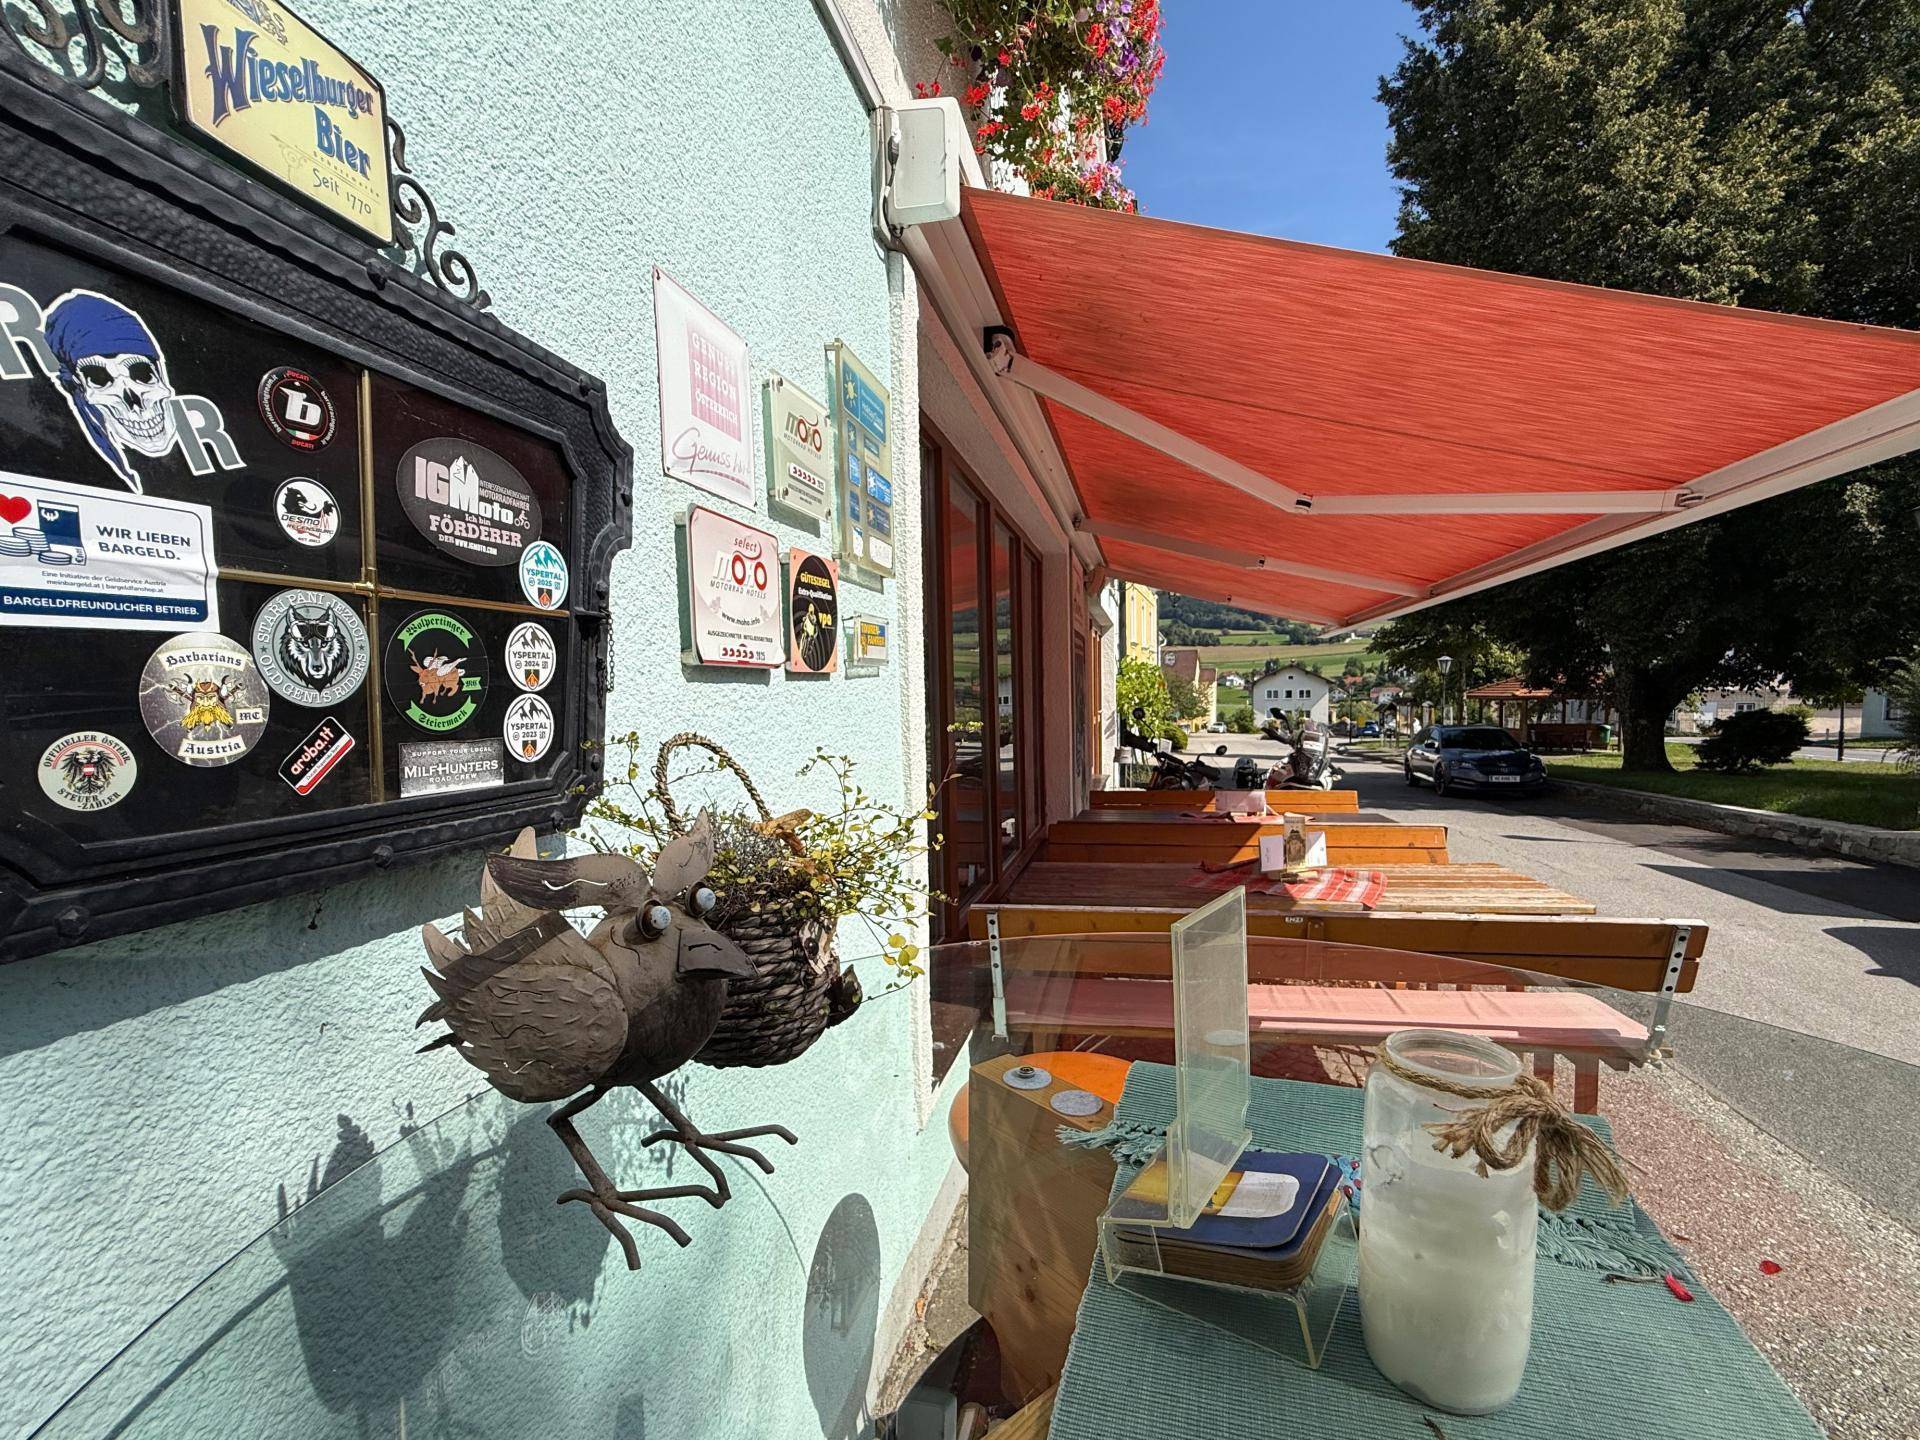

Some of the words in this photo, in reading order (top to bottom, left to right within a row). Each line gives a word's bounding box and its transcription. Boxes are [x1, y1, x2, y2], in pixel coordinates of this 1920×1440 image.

[199, 22, 374, 128] Wieselburger
[314, 105, 371, 182] Bier
[313, 168, 340, 195] Seit
[346, 191, 372, 215] 1770
[693, 359, 738, 400] REGION
[281, 513, 320, 526] DESMO
[96, 525, 131, 540] WIR
[137, 530, 191, 547] LIEBEN
[429, 513, 523, 548] FÖRDERER
[438, 534, 455, 544] DER
[98, 541, 181, 561] BARGELD.
[733, 536, 758, 553] select
[42, 570, 58, 578] Eine
[91, 574, 103, 582] der
[144, 579, 167, 587] Austria
[525, 567, 563, 581] YSPERTAL
[537, 578, 553, 587] 2025
[800, 571, 831, 589] GÜTESIEGEL
[710, 579, 744, 595] MOTORRAD
[3, 595, 153, 613] BARGELDFREUNDLICHER
[155, 605, 200, 616] BETRIEB.
[326, 598, 366, 642] JEZDCI
[405, 616, 466, 637] Wolpertinger
[165, 650, 244, 668] Barbarians
[512, 651, 550, 660] YSPERTAL
[259, 654, 284, 685] OLD
[282, 682, 333, 705] GENTS
[332, 652, 367, 696] RIDERS
[238, 710, 261, 721] MC
[418, 709, 469, 730] Steiermark
[510, 722, 548, 731] YSPERTAL
[43, 734, 97, 768] OFFIZIELLER
[183, 740, 242, 755] Austria
[290, 726, 334, 775] aruba.it
[411, 749, 447, 758] SUPPORT
[454, 772, 477, 781] CREW
[57, 787, 100, 803] STEUER
